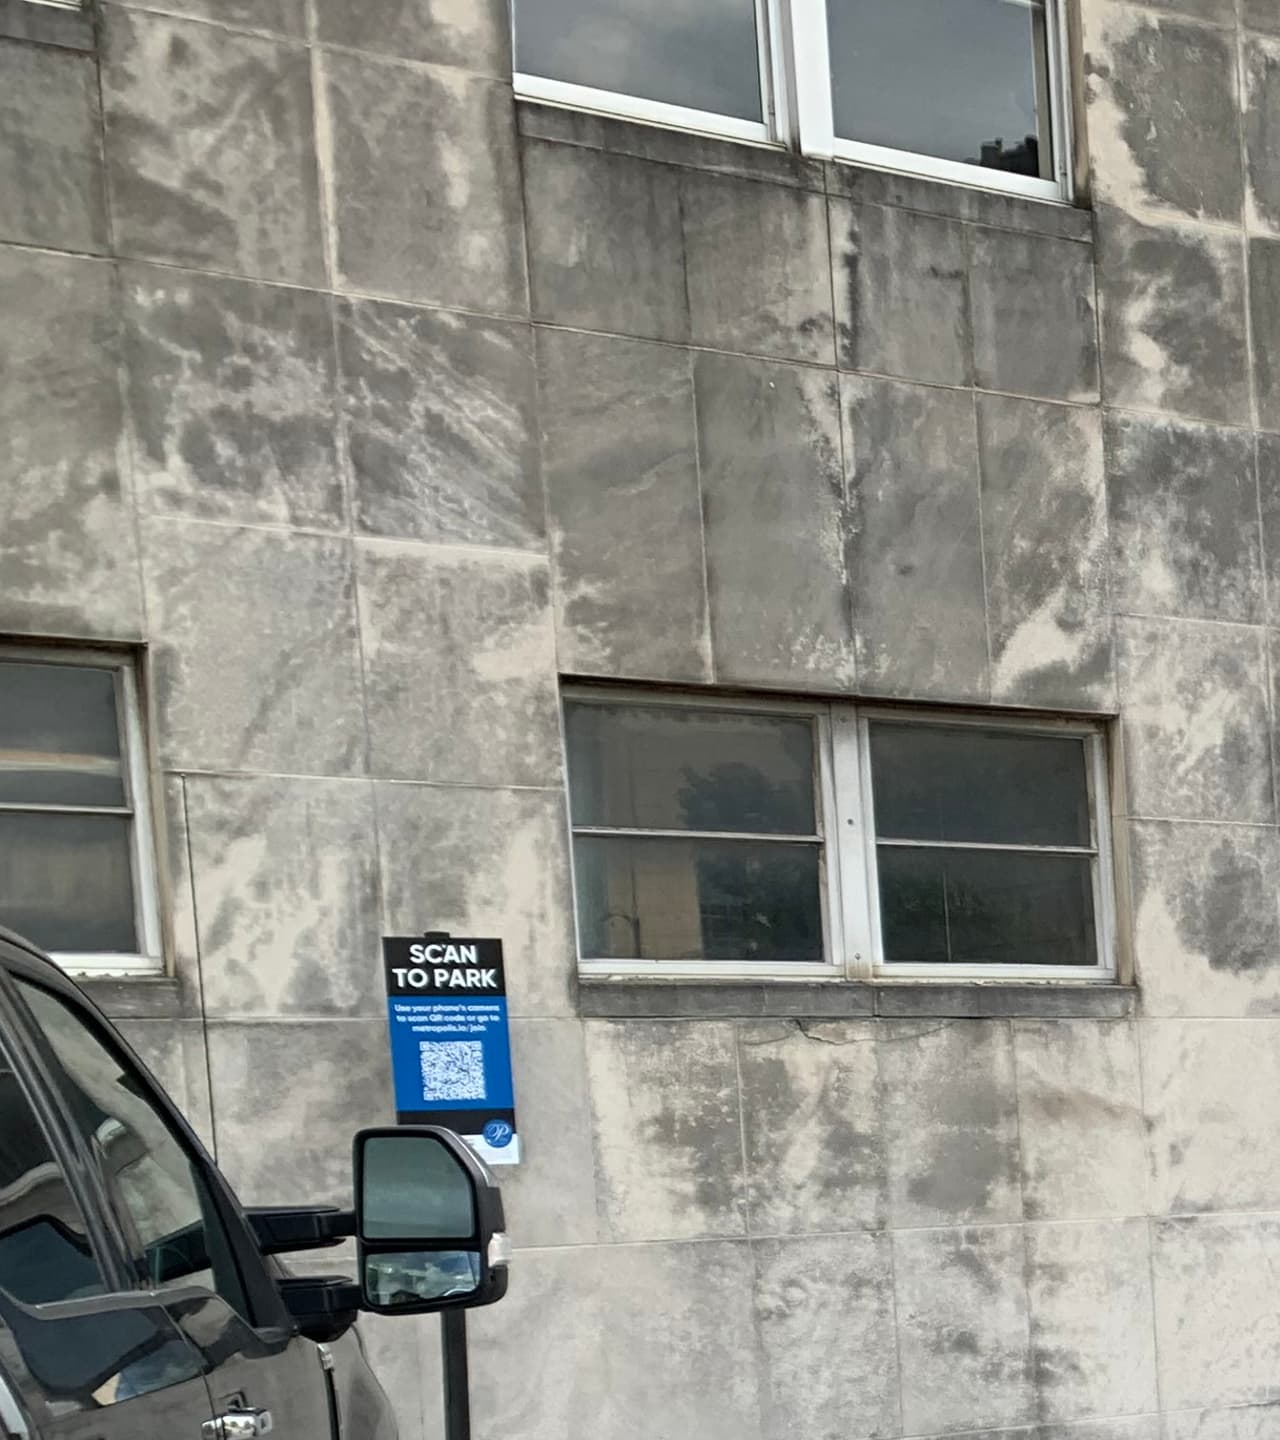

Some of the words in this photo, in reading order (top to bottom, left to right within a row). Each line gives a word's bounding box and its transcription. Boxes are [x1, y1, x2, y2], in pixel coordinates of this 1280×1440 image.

[409, 944, 477, 963] SCAN
[392, 968, 428, 988] TO
[434, 968, 498, 988] PARK
[394, 1004, 411, 1012] Use
[411, 1005, 432, 1013] your
[429, 1014, 443, 1022] QR
